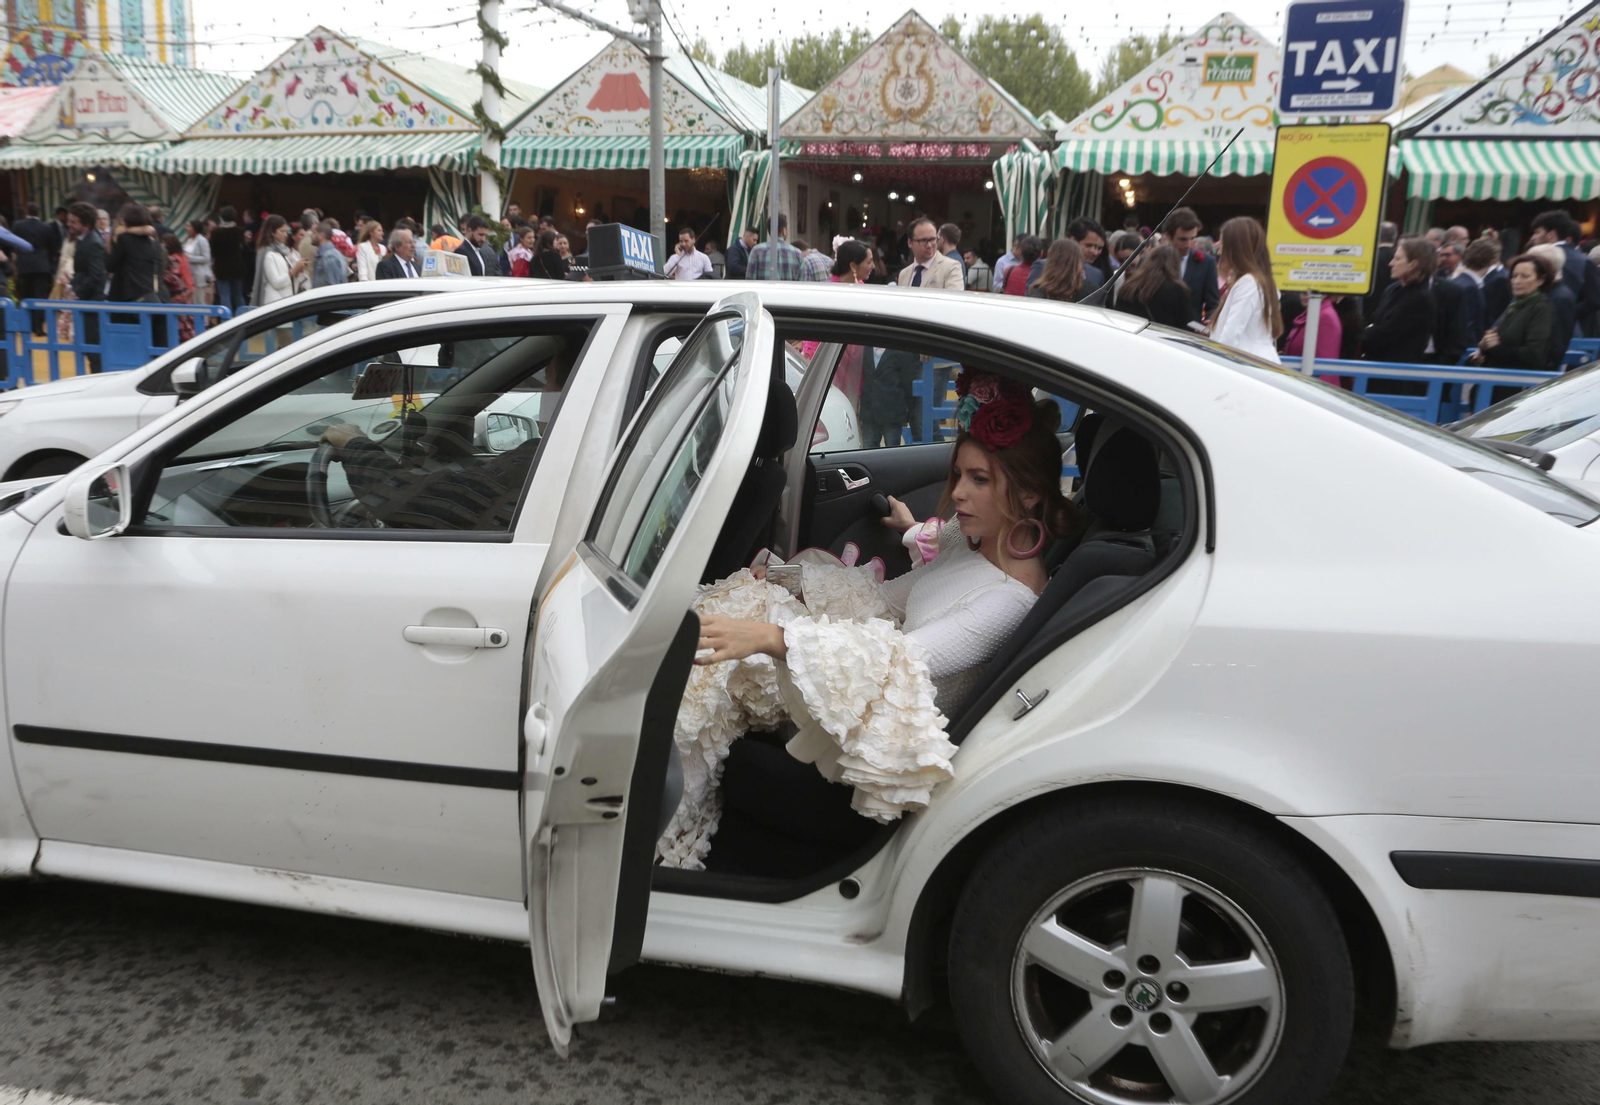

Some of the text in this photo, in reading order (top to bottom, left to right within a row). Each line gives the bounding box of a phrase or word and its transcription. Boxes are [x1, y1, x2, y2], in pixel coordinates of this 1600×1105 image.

[1287, 37, 1397, 77] TAXI
[1211, 126, 1223, 138] 17
[620, 228, 655, 263] TAXI
[446, 255, 463, 273] TAXI
